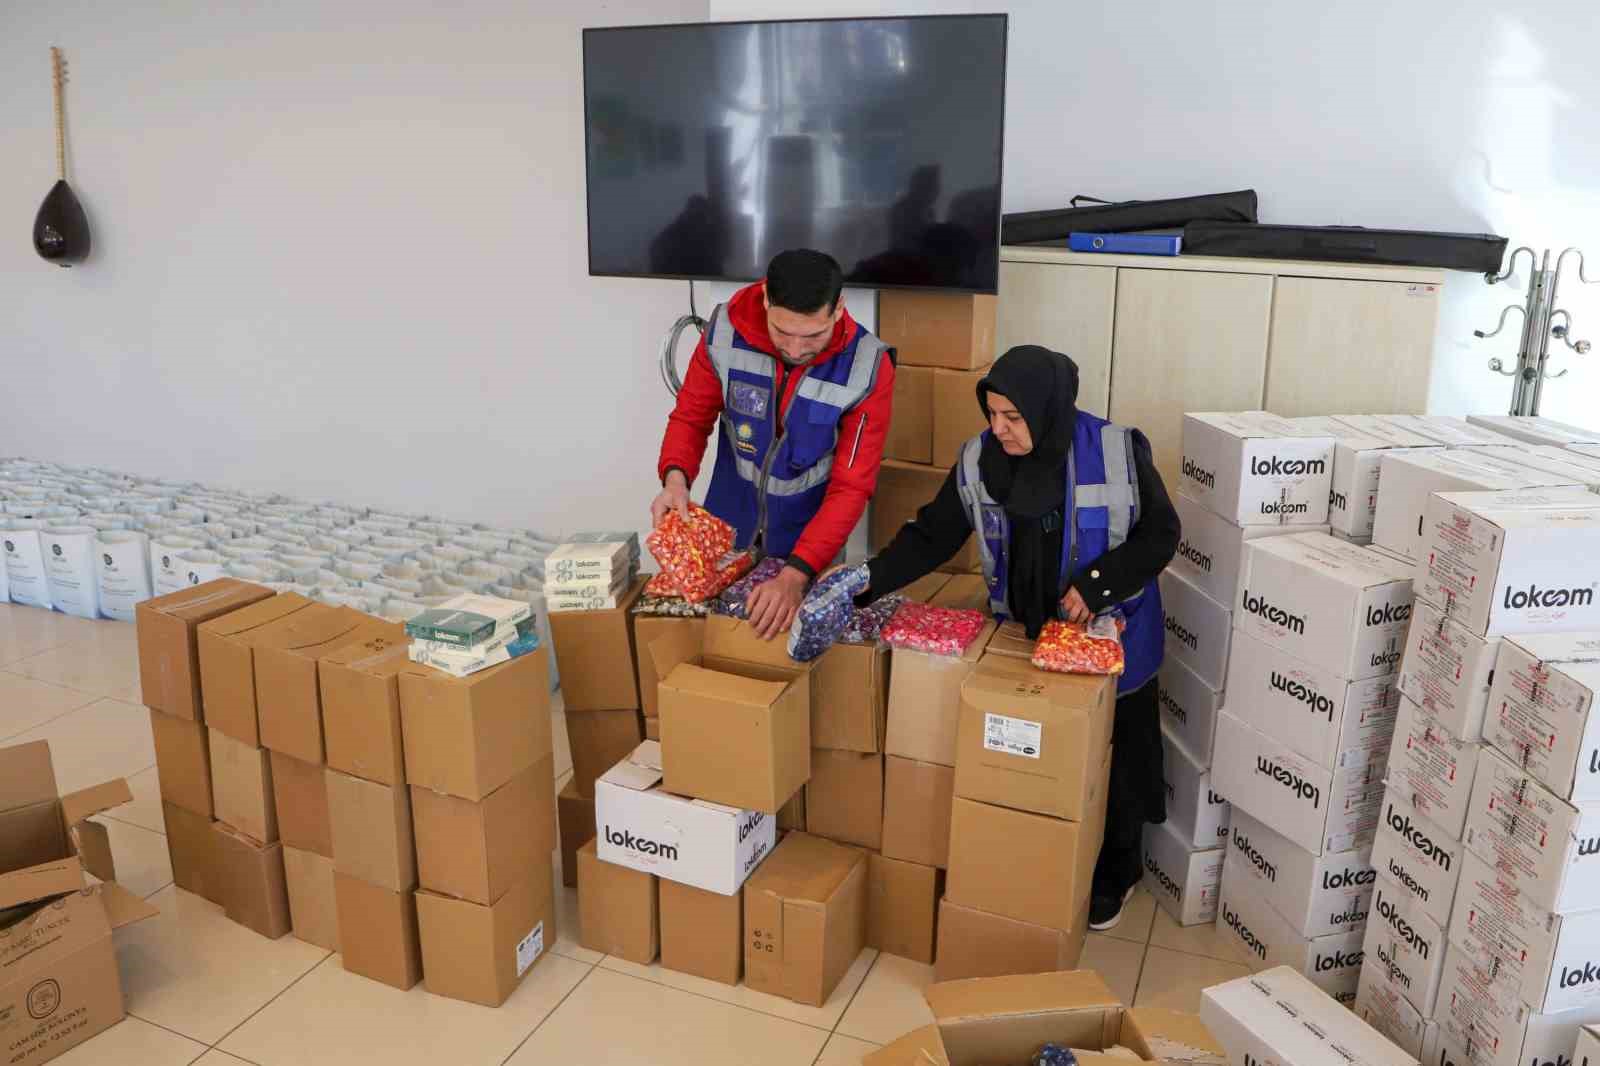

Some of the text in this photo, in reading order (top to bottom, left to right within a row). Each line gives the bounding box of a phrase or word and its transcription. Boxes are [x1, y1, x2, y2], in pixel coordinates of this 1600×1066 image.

[1176, 540, 1211, 572] okoom
[1366, 602, 1411, 627] lokoo
[1322, 867, 1376, 890] lokoo
